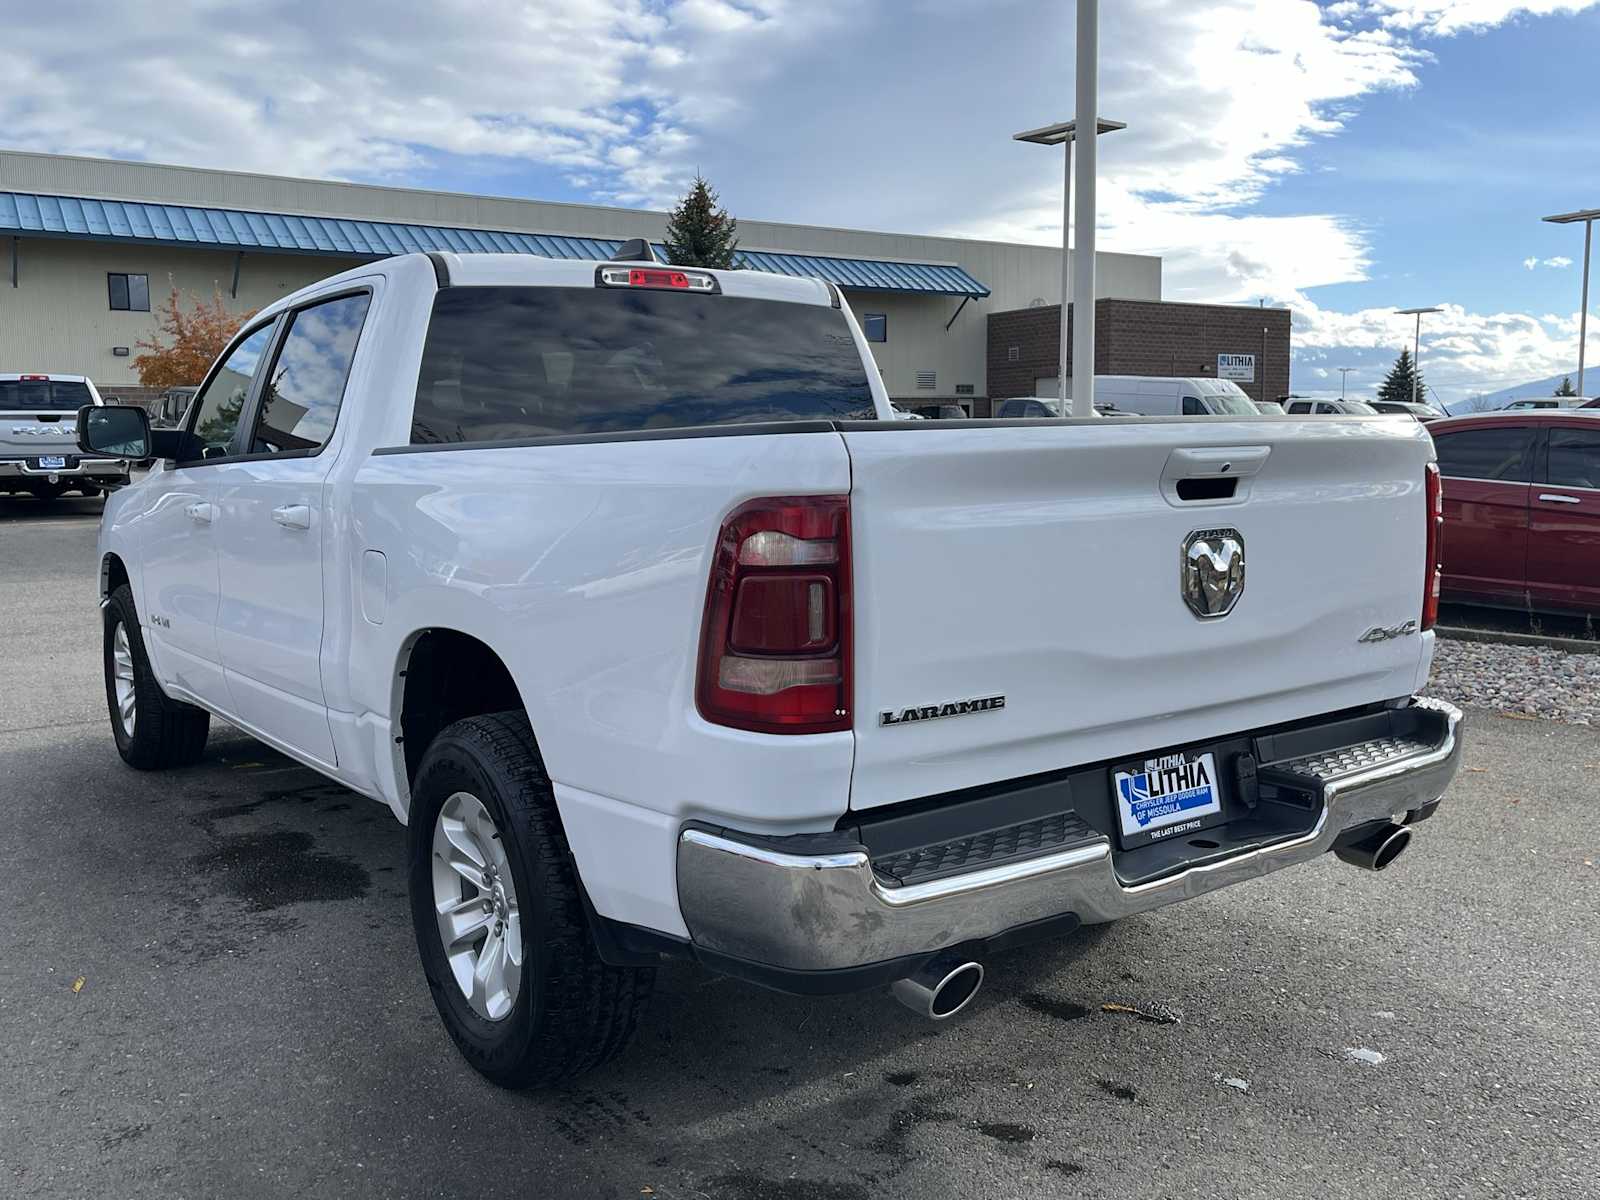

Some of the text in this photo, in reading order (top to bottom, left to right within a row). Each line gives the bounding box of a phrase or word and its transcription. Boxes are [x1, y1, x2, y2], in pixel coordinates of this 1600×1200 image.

[1227, 355, 1253, 367] LITHIA
[879, 694, 1006, 728] LARAMIE
[1154, 753, 1185, 770] LITHIA
[1148, 762, 1210, 798] LITHIA
[1136, 788, 1208, 810] CHRYSLER JEEP DODGE RAM
[1137, 803, 1180, 820] OF MISSOULA
[1151, 820, 1201, 839] THE LAST BEST PRICE
